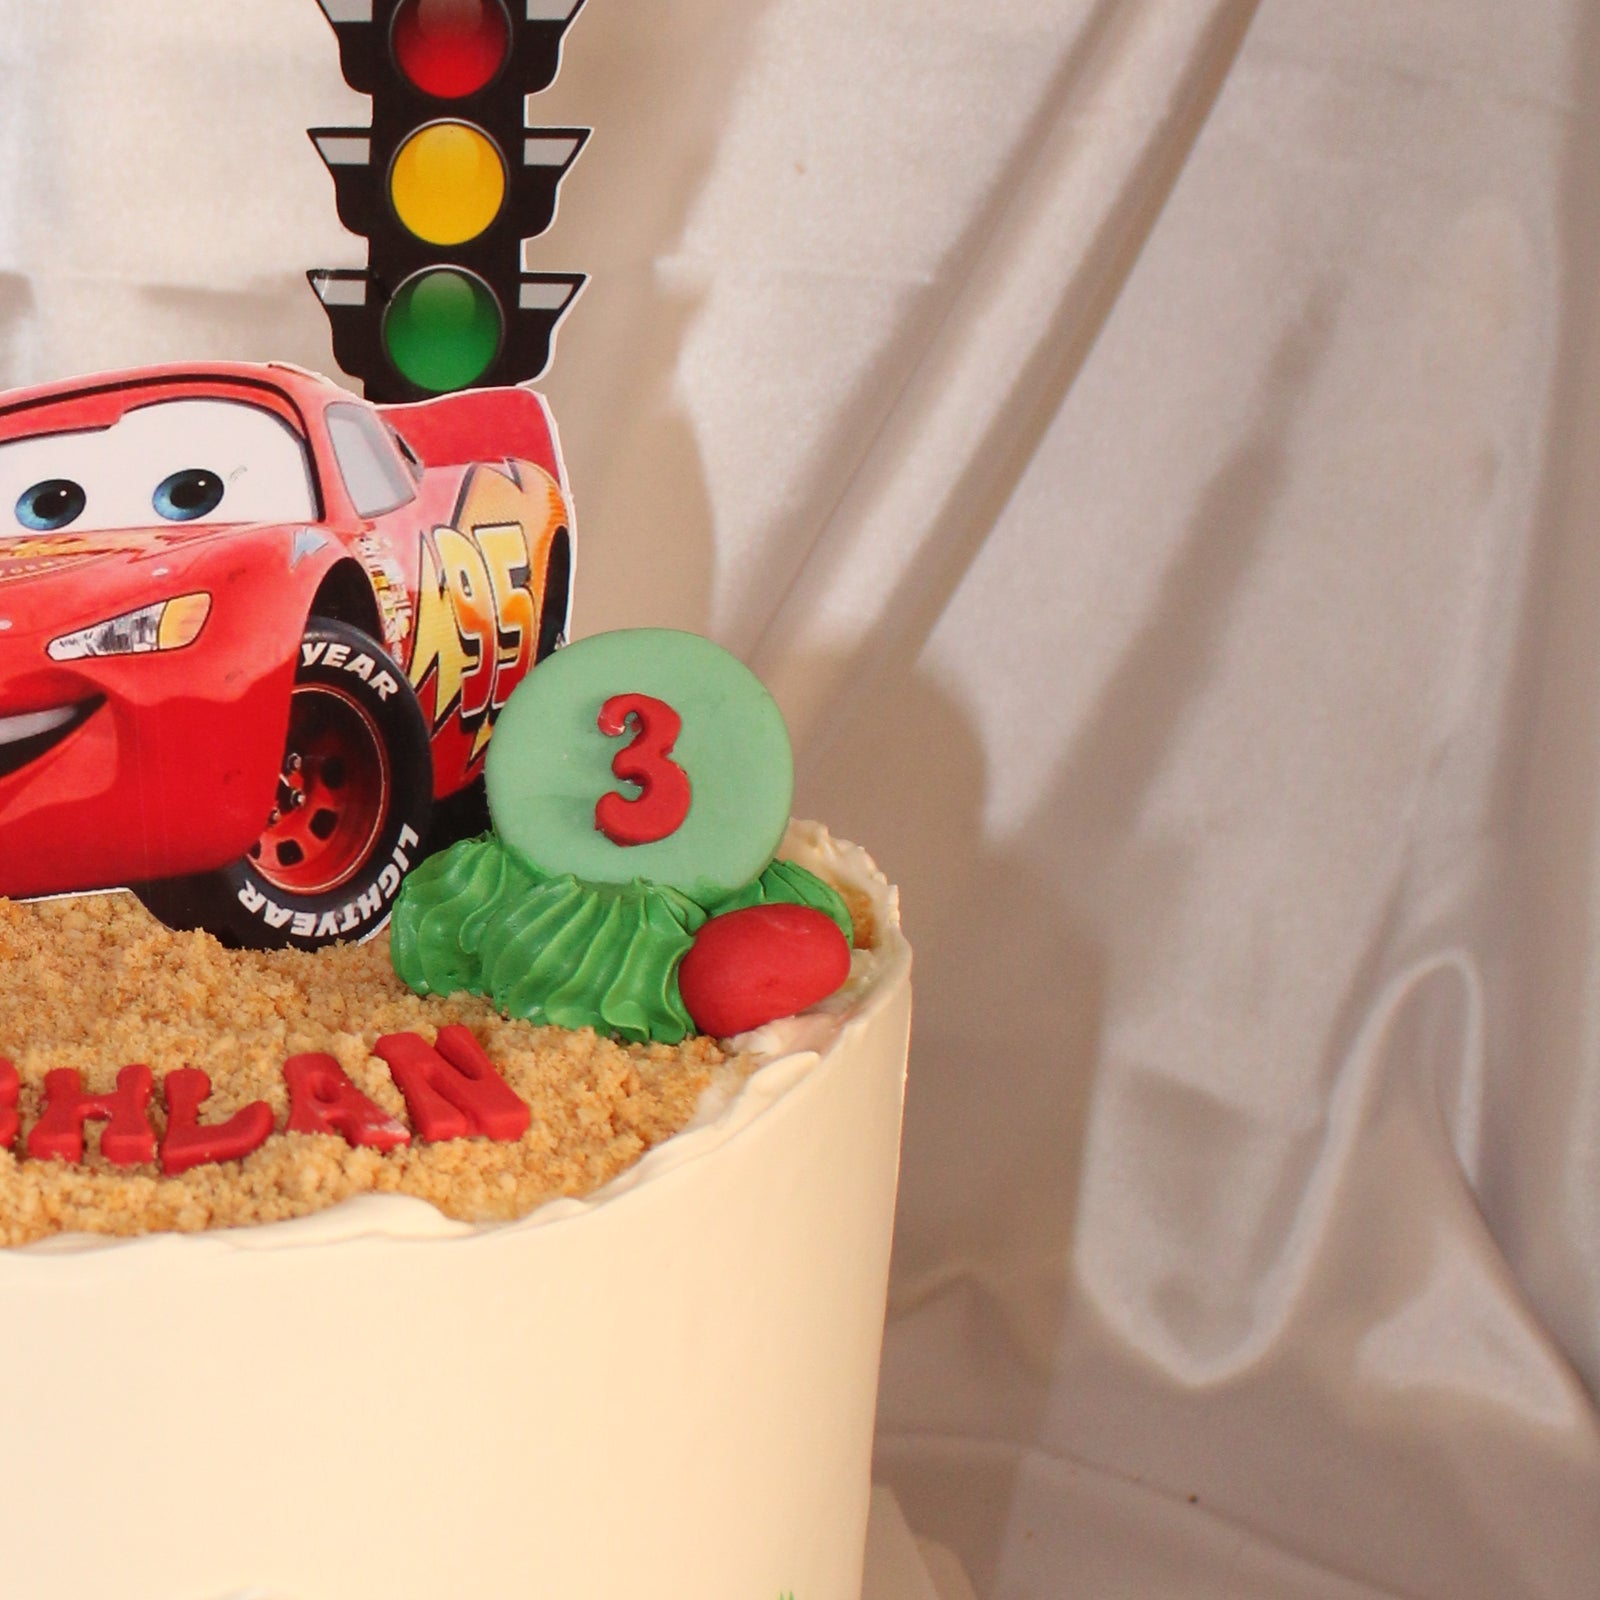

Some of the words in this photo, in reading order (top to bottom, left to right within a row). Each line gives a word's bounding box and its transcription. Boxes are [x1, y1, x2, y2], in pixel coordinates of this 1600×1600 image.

[301, 641, 400, 701] YEAR
[432, 522, 537, 720] 95
[594, 692, 692, 848] 3
[237, 822, 420, 938] LIGHTYEAR
